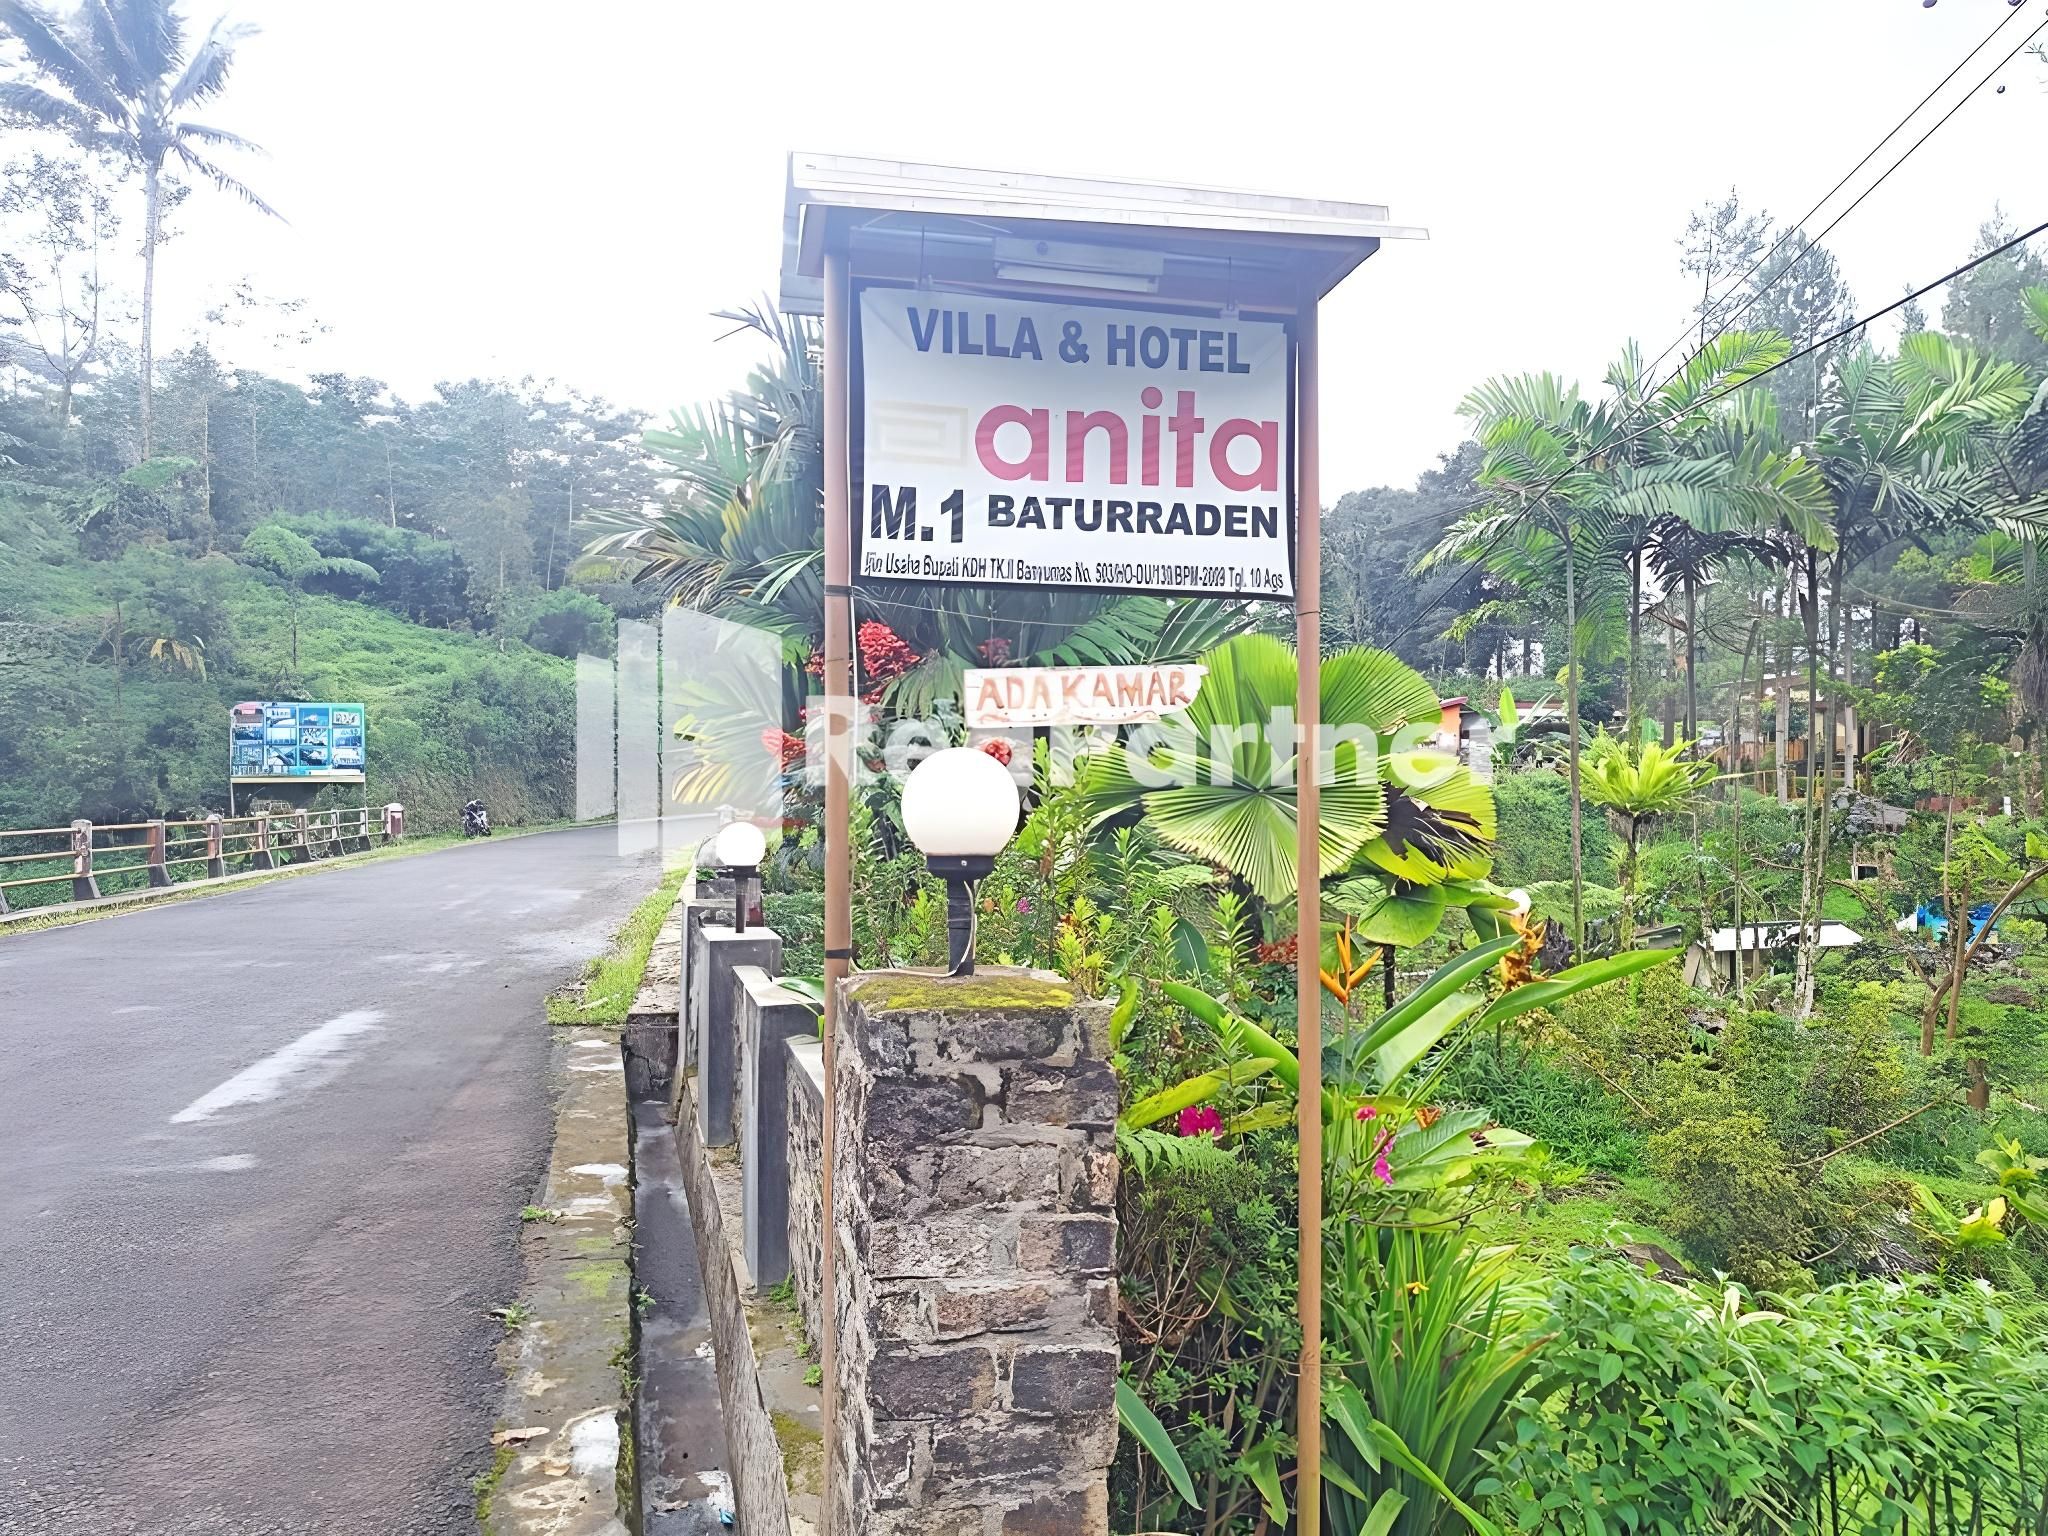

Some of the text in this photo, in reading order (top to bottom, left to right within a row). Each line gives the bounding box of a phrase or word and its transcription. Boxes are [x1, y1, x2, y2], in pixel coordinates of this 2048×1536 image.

[906, 306, 1251, 374] VILLA & HOTEL
[974, 386, 1279, 492] anita
[870, 484, 1279, 543] M.1 BATURRADEN
[886, 553, 920, 575] Usaha
[923, 555, 960, 580] Bupati
[962, 557, 987, 579] KDH
[1016, 559, 1072, 584] Banyumas
[1250, 568, 1262, 588] 10
[1263, 568, 1284, 592] Ags
[976, 671, 1192, 711] ADA KAMAR
